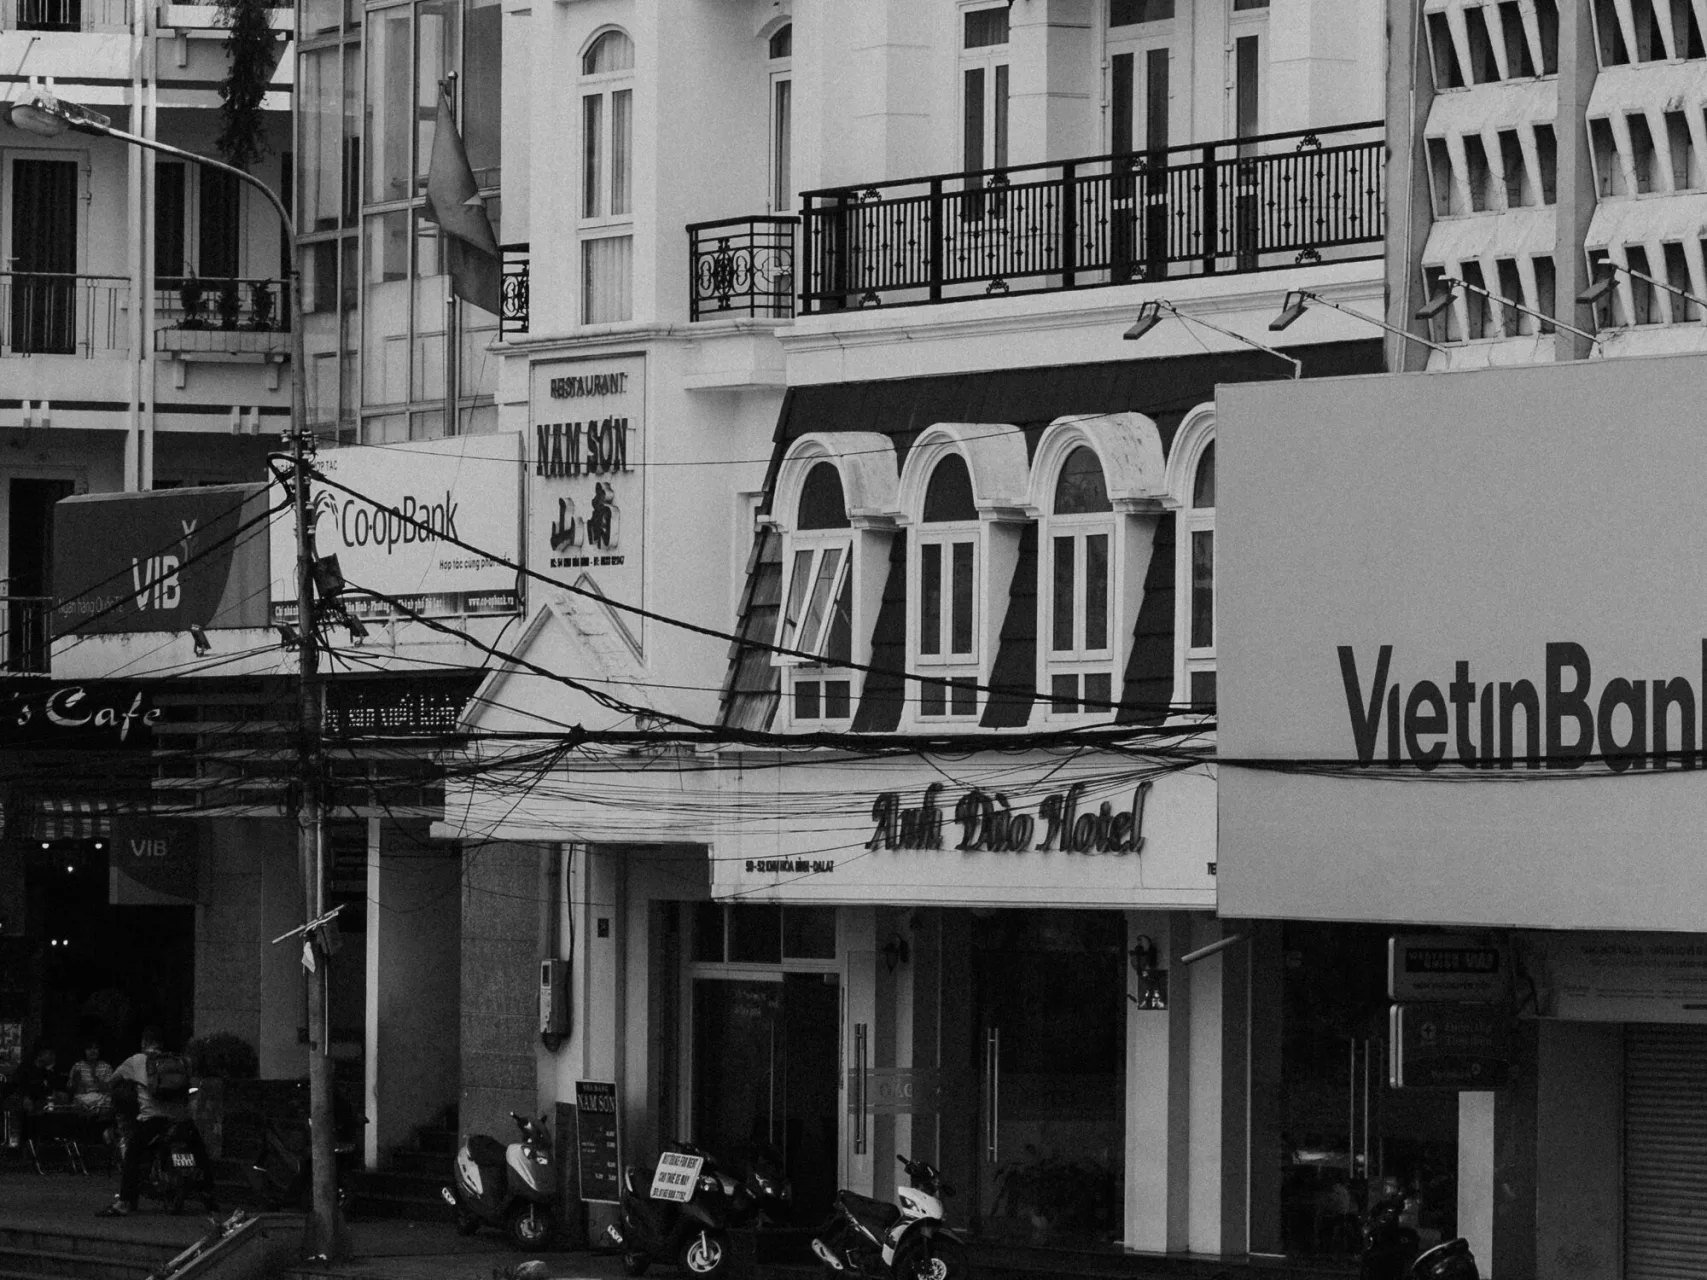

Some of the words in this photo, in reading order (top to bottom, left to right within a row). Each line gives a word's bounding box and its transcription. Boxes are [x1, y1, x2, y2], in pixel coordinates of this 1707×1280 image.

[551, 372, 627, 398] RESTAURANT
[537, 422, 582, 479] NAM
[132, 555, 181, 611] VIB
[1337, 638, 1707, 772] VietinBan
[1035, 781, 1153, 855] Hotel
[130, 839, 168, 856] VIB
